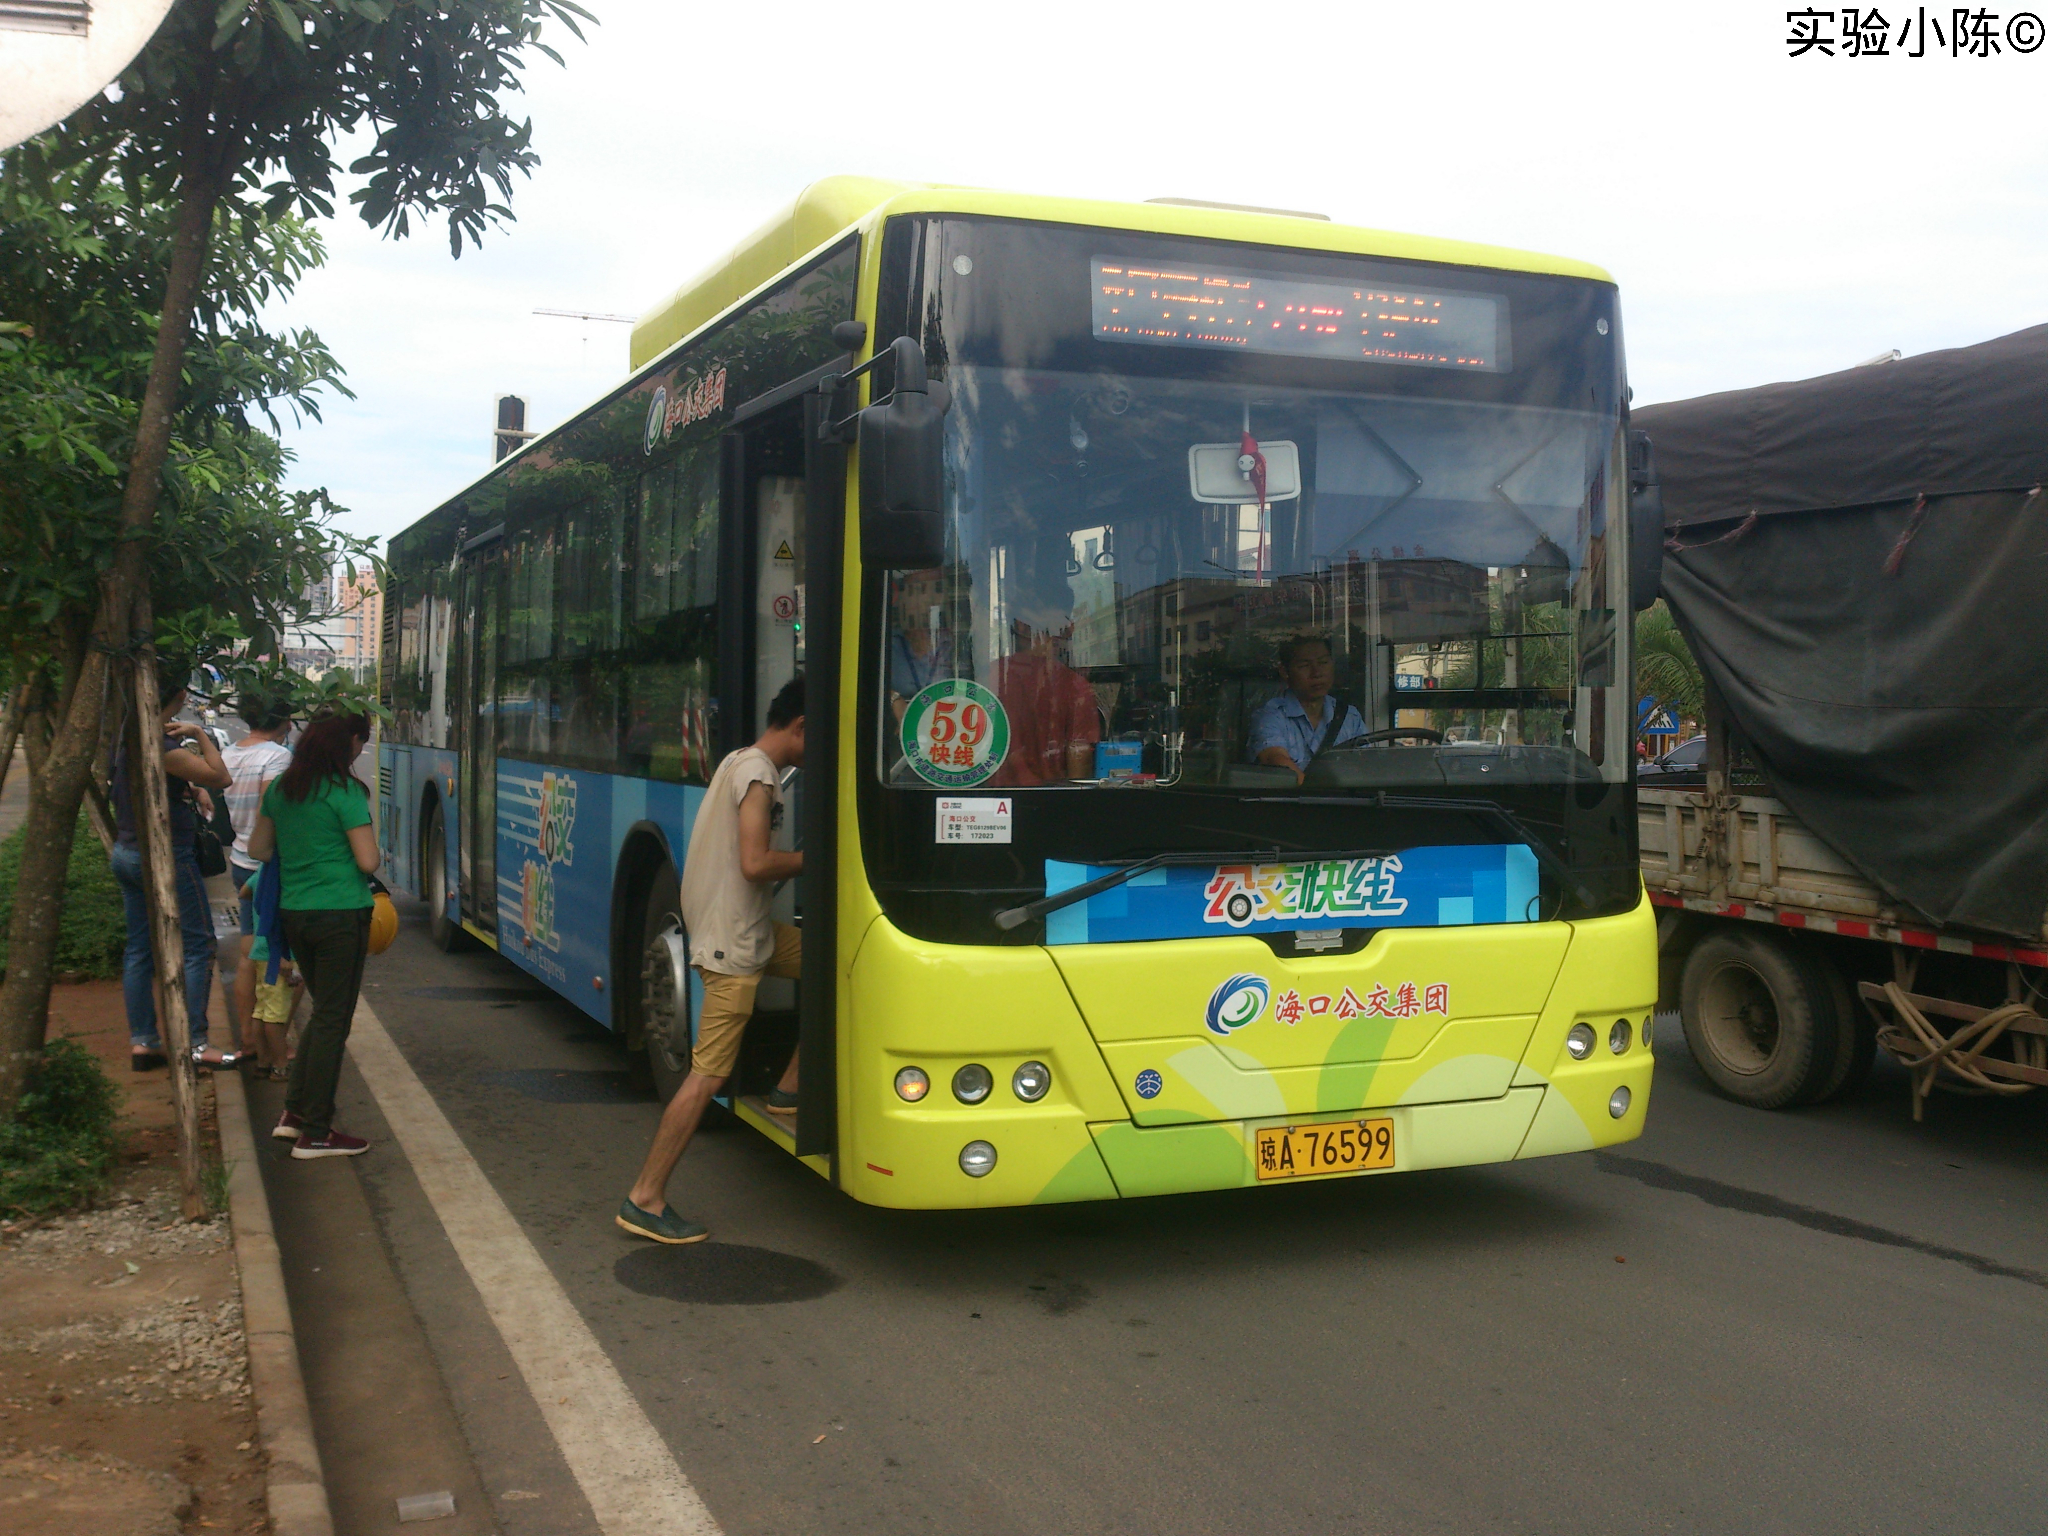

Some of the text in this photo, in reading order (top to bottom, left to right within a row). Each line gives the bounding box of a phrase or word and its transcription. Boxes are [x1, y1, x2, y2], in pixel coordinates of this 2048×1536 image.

[930, 700, 988, 746] 59
[928, 743, 975, 768] 快线
[949, 815, 976, 823] 海口公交
[996, 801, 1008, 815] A
[1203, 854, 1408, 928] 公交快线
[1274, 982, 1449, 1026] 海口公交集团
